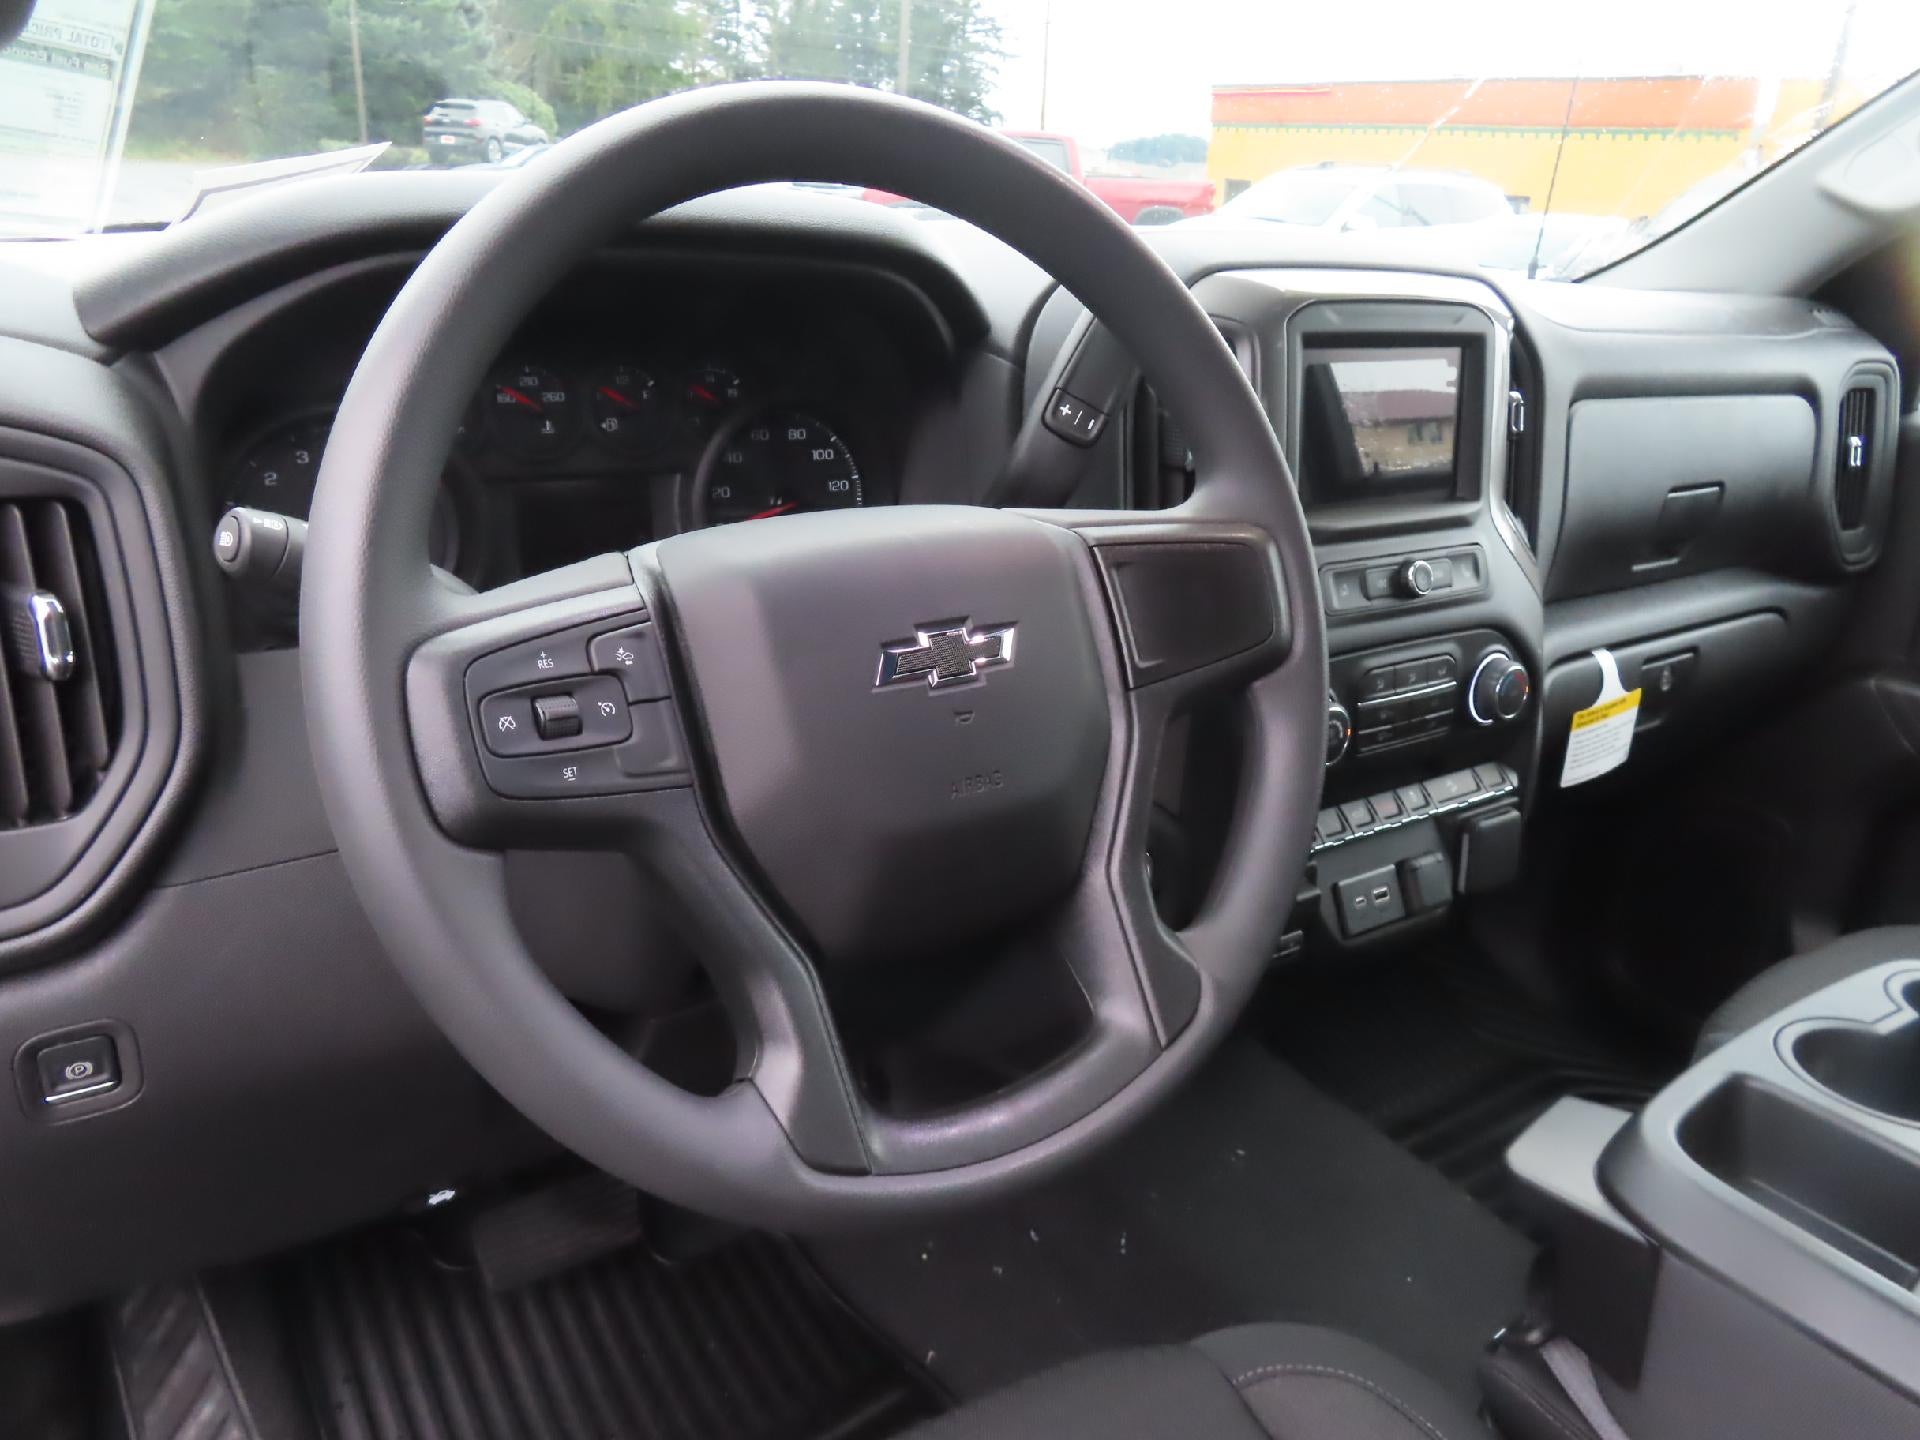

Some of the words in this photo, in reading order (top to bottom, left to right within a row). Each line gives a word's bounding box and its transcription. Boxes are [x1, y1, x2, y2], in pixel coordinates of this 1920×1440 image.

[788, 428, 807, 441] 80
[296, 450, 310, 464] 3
[812, 448, 834, 460] 100
[264, 472, 278, 486] 2
[829, 480, 849, 491] 120
[712, 486, 731, 498] 20
[537, 658, 554, 670] RES
[563, 766, 577, 778] SET
